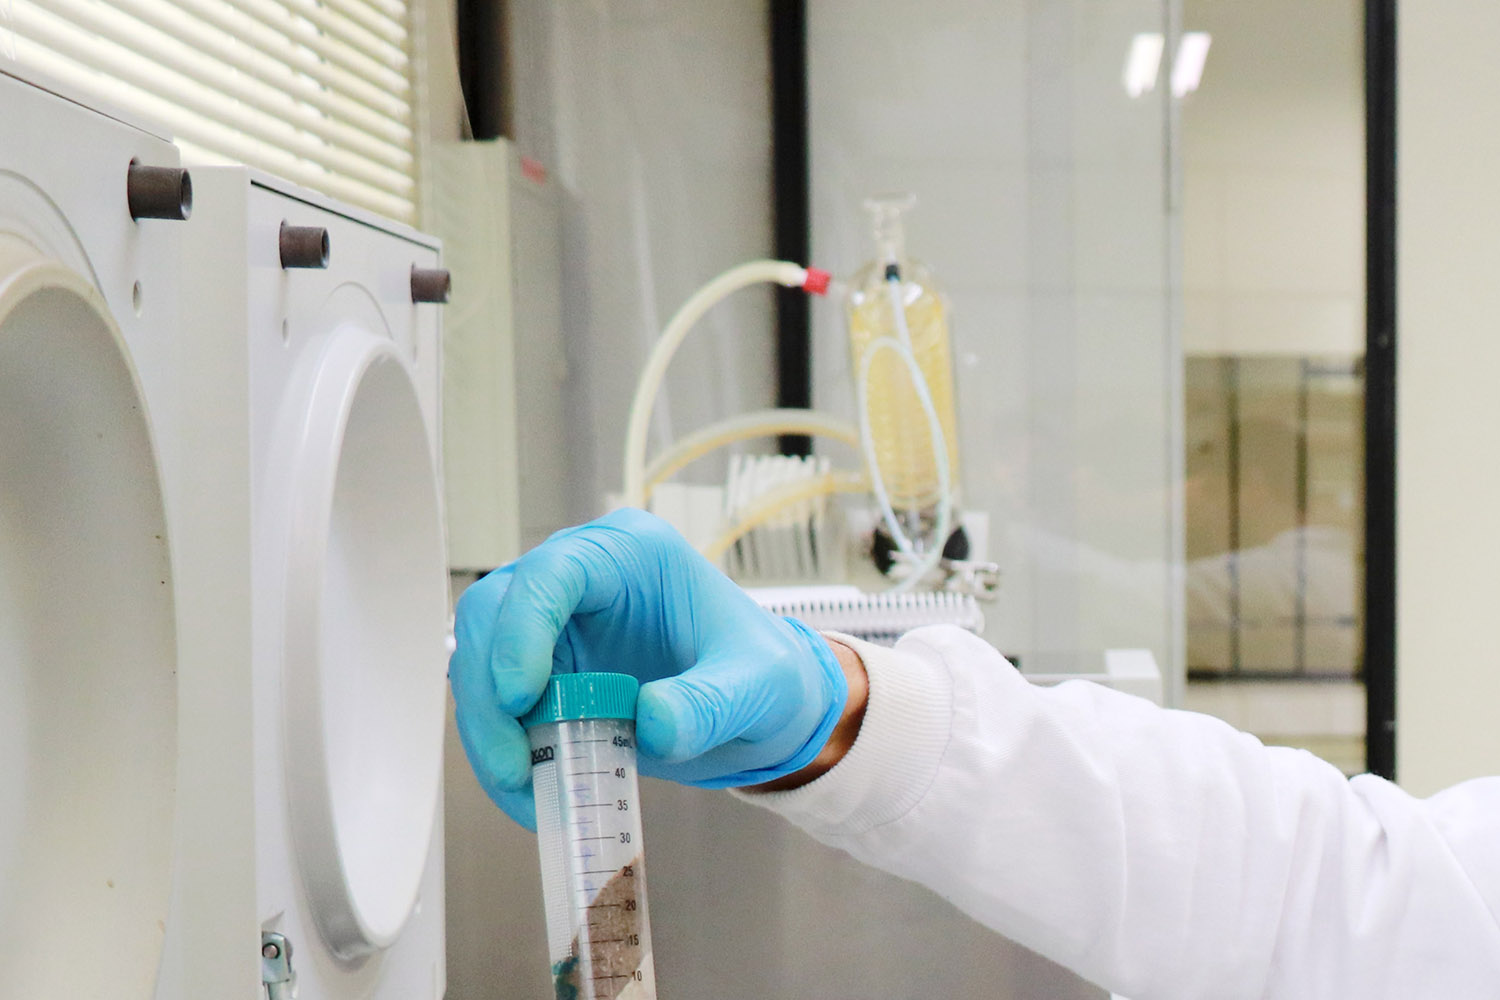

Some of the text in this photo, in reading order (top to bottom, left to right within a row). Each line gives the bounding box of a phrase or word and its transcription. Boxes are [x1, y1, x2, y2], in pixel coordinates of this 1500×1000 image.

[615, 767, 625, 779] 40
[617, 800, 629, 812] 35
[620, 832, 631, 844] 30
[623, 866, 634, 877] 25
[625, 899, 637, 911] 20
[629, 934, 639, 946] 15
[631, 970, 642, 982] 10
